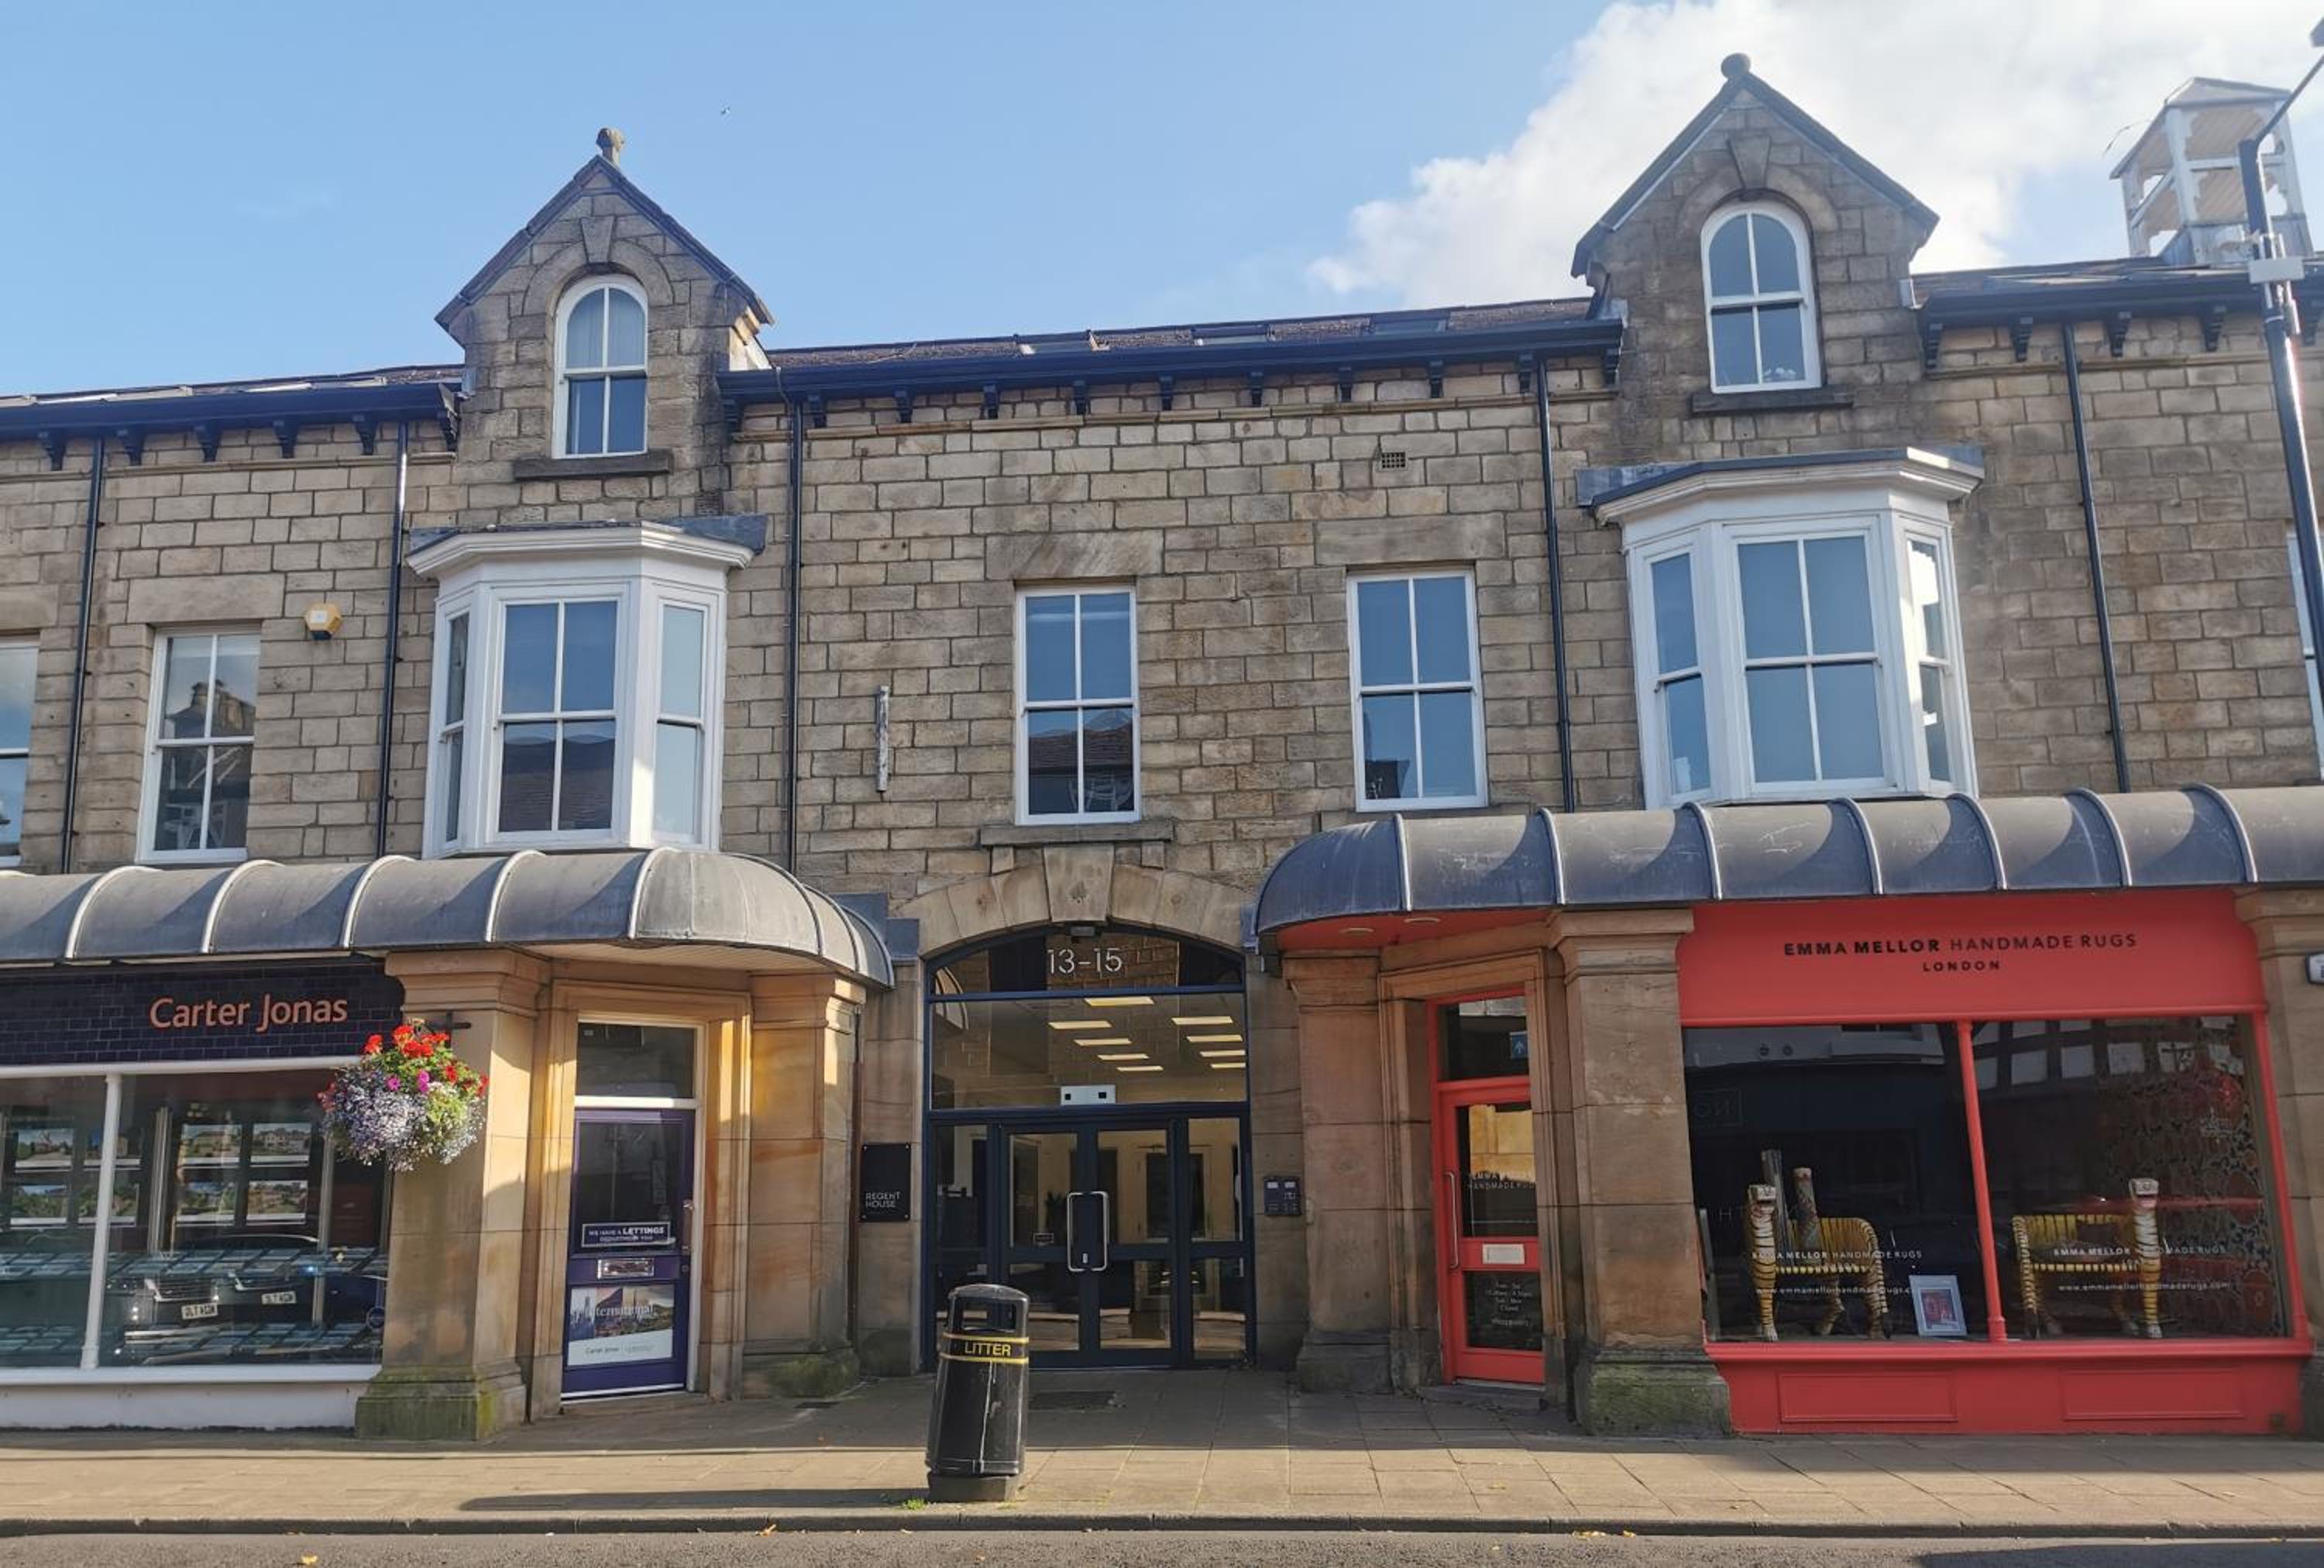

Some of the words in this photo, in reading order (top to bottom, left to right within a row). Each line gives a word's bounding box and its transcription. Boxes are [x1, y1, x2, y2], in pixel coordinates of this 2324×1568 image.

[1784, 941, 1848, 955] EMMA
[1855, 939, 1940, 954] MELLOR
[1950, 935, 2074, 951] HANDMADE
[2081, 934, 2137, 948] RUGS
[1047, 947, 1122, 974] 13-15
[1923, 960, 2000, 972] LONDON
[150, 996, 250, 1029] Carter
[256, 992, 348, 1033] Jonas
[865, 1191, 900, 1201] REGENT
[865, 1200, 896, 1209] HOUSE
[622, 1226, 664, 1235] LETTINGS
[1786, 1250, 1827, 1259] MELLOR
[1894, 1250, 1922, 1259] RUGS
[964, 1341, 1011, 1357] LITTER
